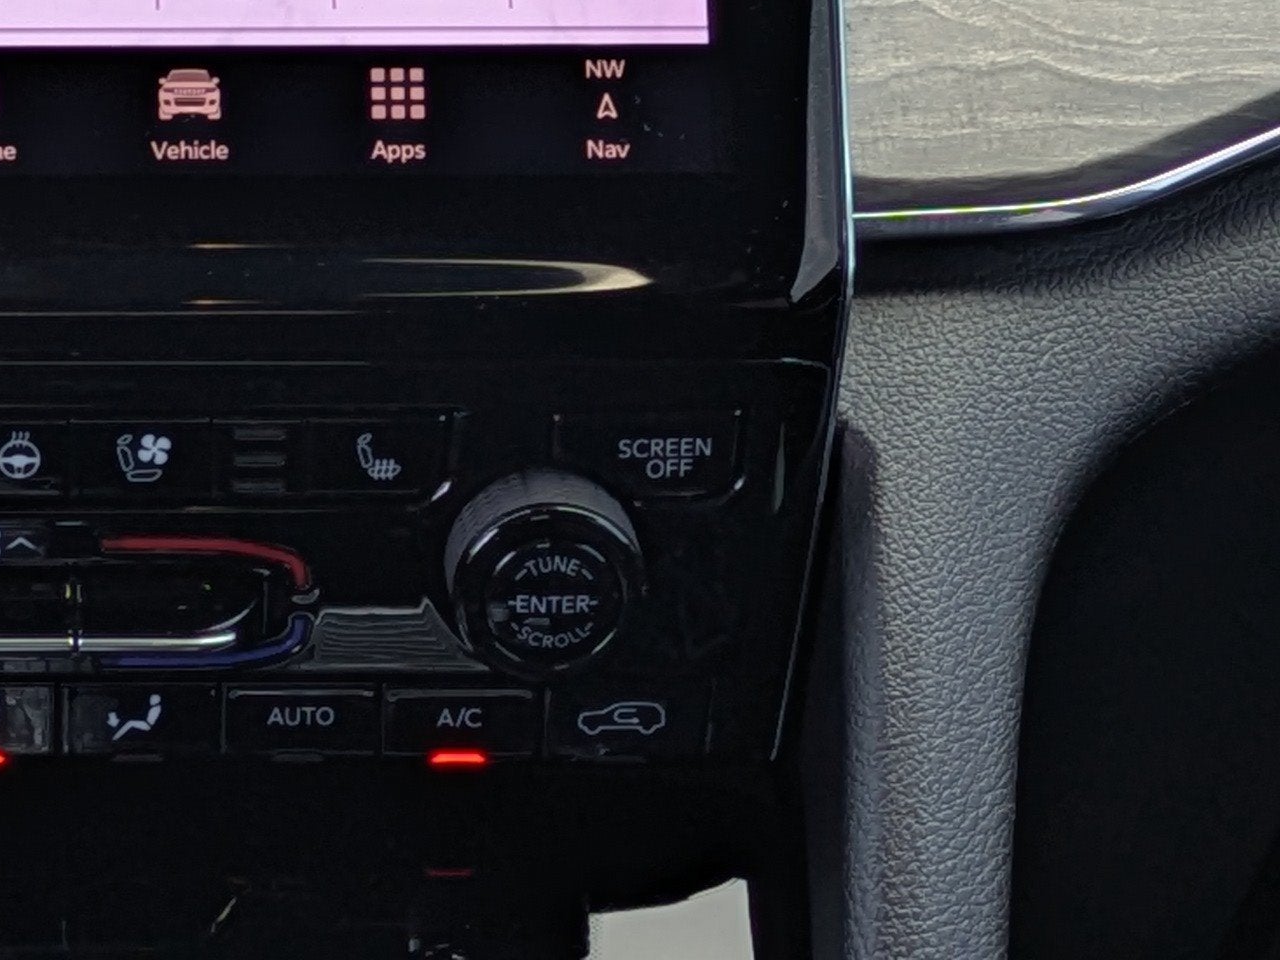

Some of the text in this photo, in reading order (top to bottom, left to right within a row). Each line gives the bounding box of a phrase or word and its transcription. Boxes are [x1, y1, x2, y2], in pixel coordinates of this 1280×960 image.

[585, 59, 625, 79] NW
[151, 140, 229, 161] Vehicle
[371, 140, 426, 165] Apps
[586, 140, 630, 159] Nav
[618, 437, 712, 460] SCREEN
[645, 458, 694, 479] OFF
[524, 556, 581, 577] TUNE
[516, 595, 590, 614] ENTER
[517, 624, 588, 649] SCROLL
[267, 706, 335, 727] AUTO
[436, 707, 483, 728] A/C
